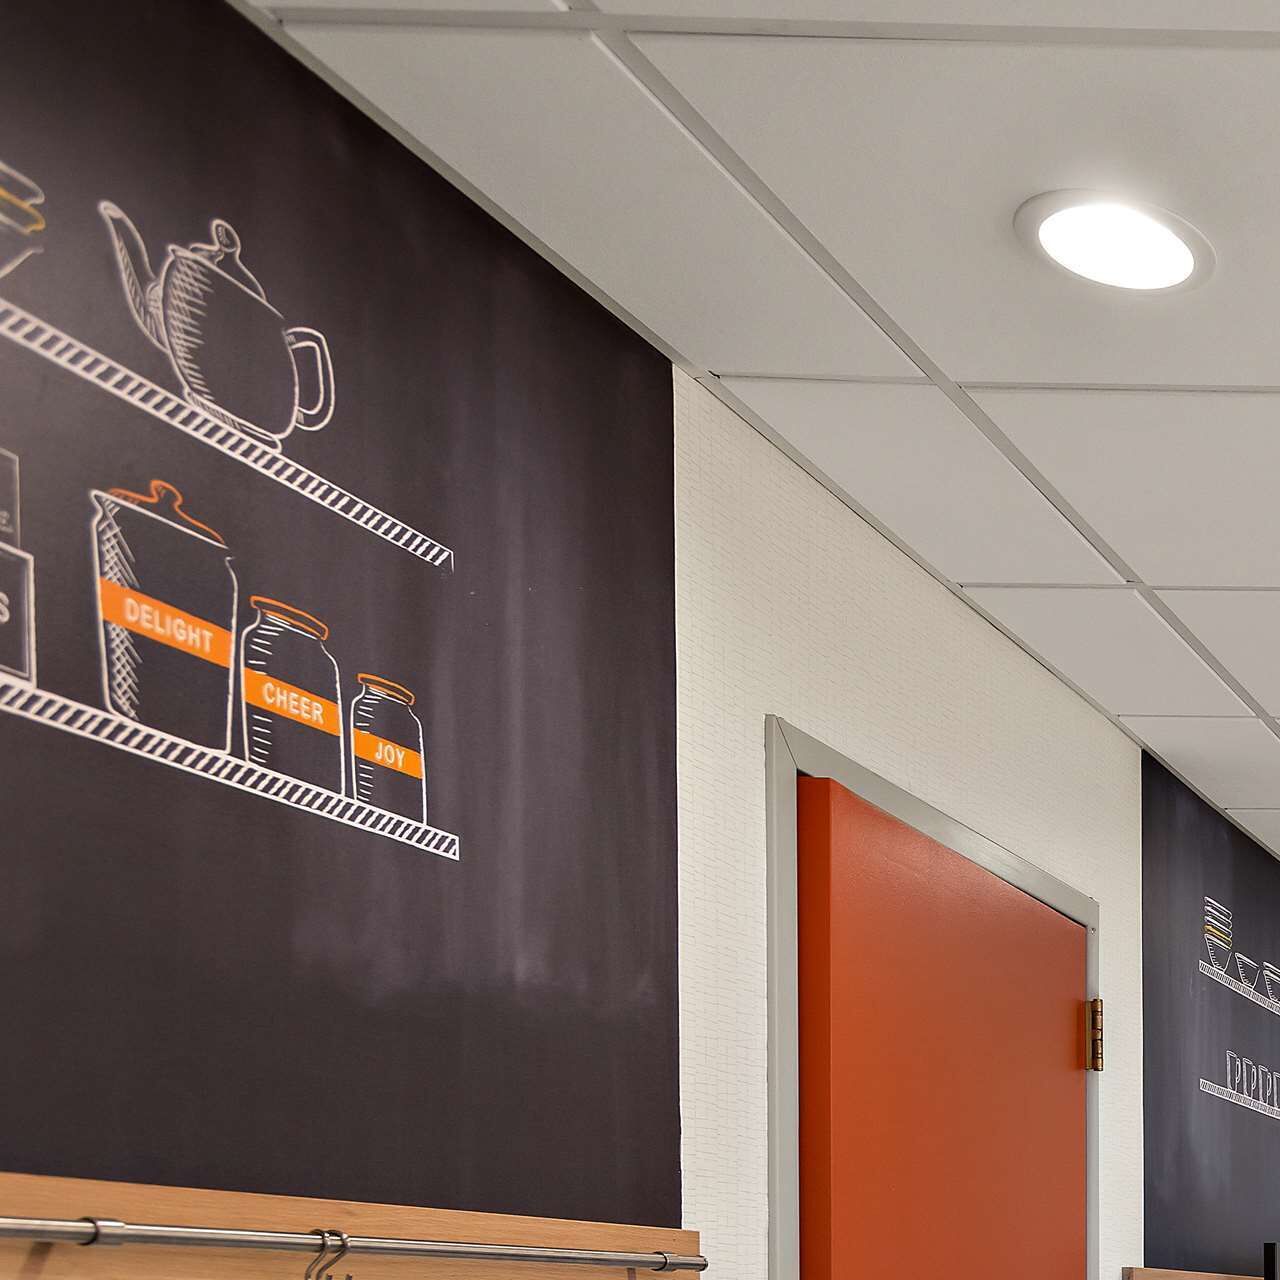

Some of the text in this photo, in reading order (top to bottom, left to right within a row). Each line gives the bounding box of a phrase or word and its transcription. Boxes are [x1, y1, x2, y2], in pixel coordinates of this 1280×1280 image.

[123, 598, 214, 653] DELIGHT
[262, 681, 325, 725] CHEER
[375, 747, 406, 770] JOY
